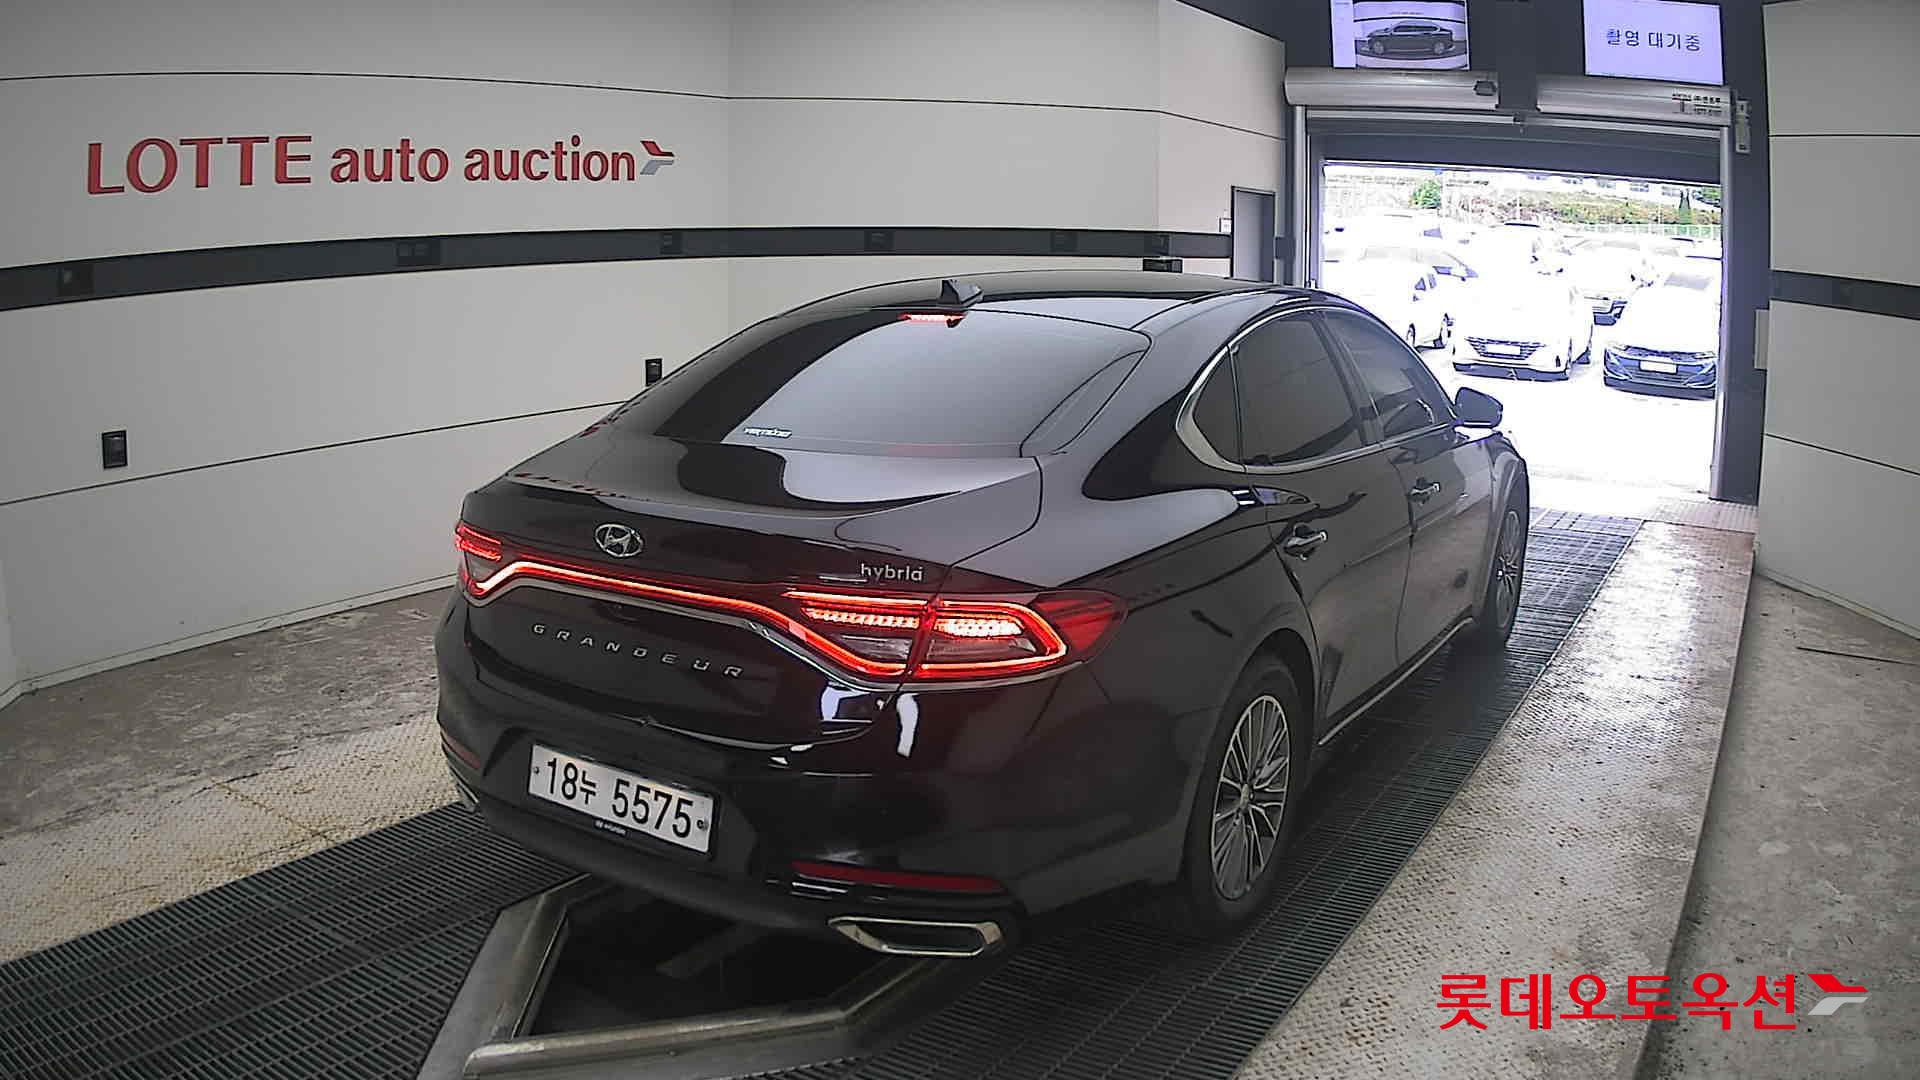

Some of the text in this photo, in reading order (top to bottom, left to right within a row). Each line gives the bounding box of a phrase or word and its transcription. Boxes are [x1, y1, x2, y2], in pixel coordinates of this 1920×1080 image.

[1648, 32, 1701, 52] 대기중
[87, 134, 637, 195] LOTTE auto auction
[860, 563, 924, 582] hybrid
[532, 623, 744, 678] GRANDEUR
[547, 757, 694, 838] 18누 5575
